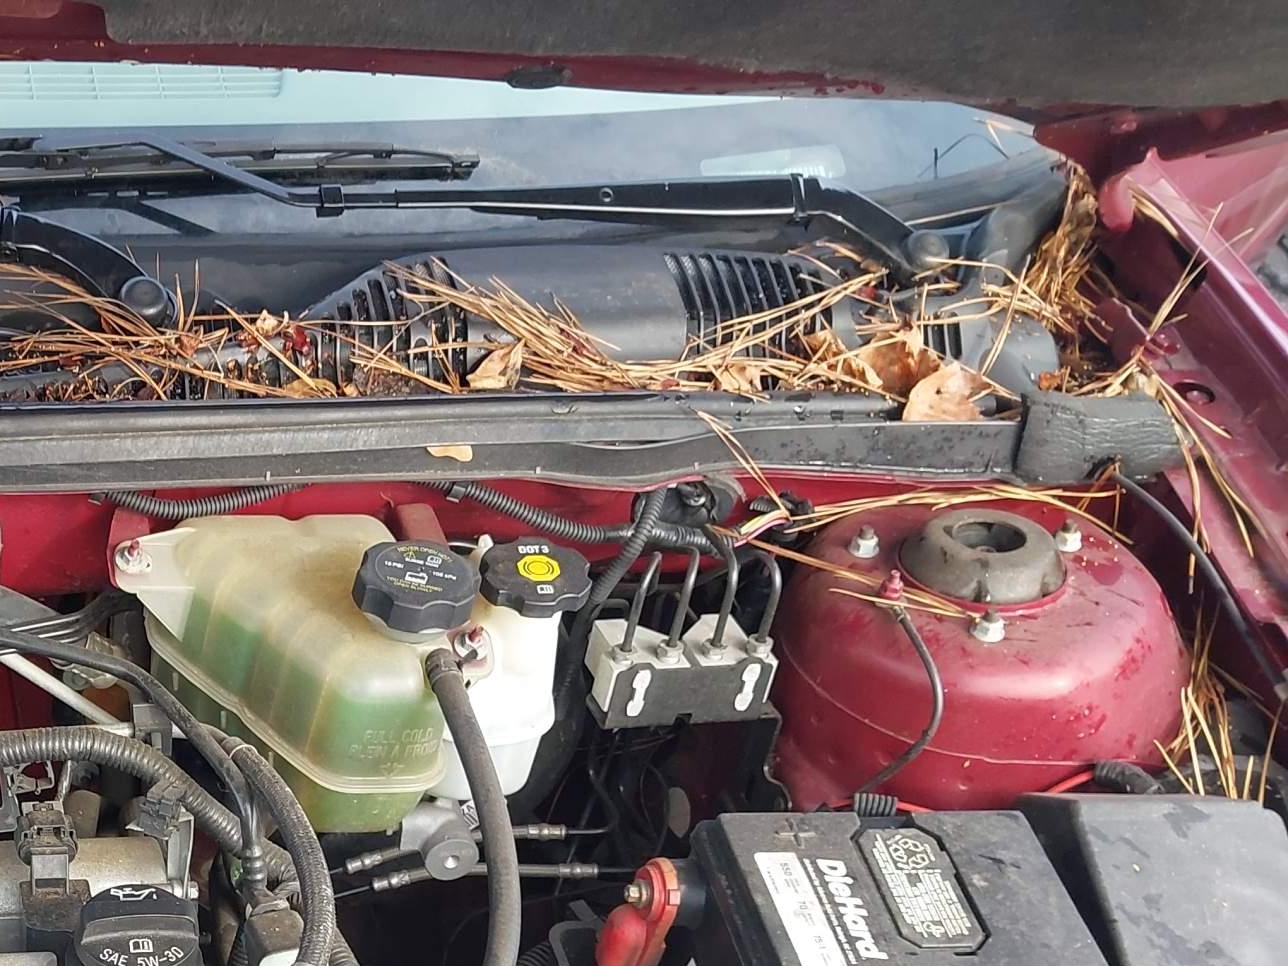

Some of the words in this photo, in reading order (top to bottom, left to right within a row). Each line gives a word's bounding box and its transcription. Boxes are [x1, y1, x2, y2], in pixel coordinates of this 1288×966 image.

[518, 545, 540, 554] DOT
[541, 545, 550, 553] 3
[401, 727, 434, 743] COLD
[815, 858, 889, 960] DieHard
